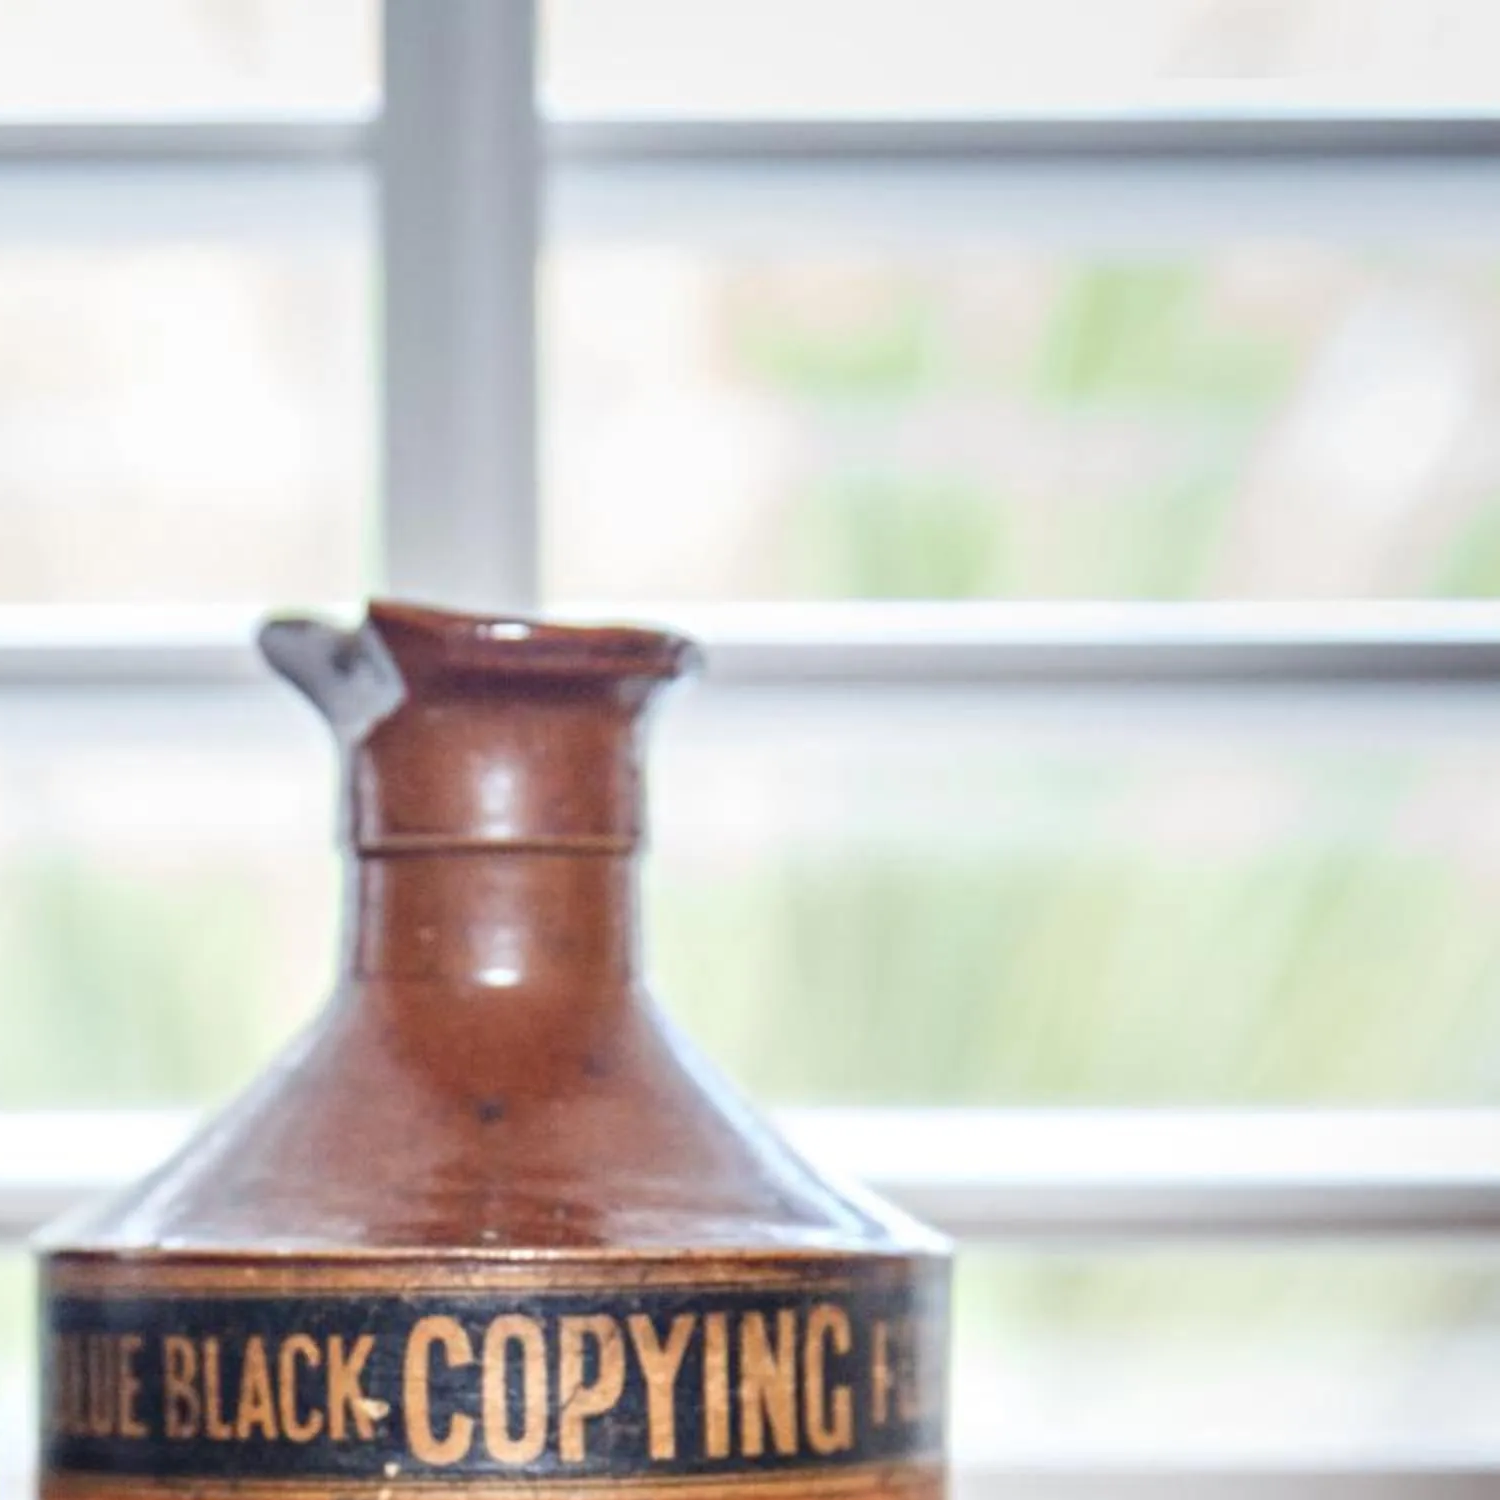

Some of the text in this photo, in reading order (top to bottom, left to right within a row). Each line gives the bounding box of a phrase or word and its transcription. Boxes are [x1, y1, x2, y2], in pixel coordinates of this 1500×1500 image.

[52, 1334, 150, 1438] LUE
[163, 1333, 376, 1441] BLACK
[403, 1302, 852, 1465] COPYING
